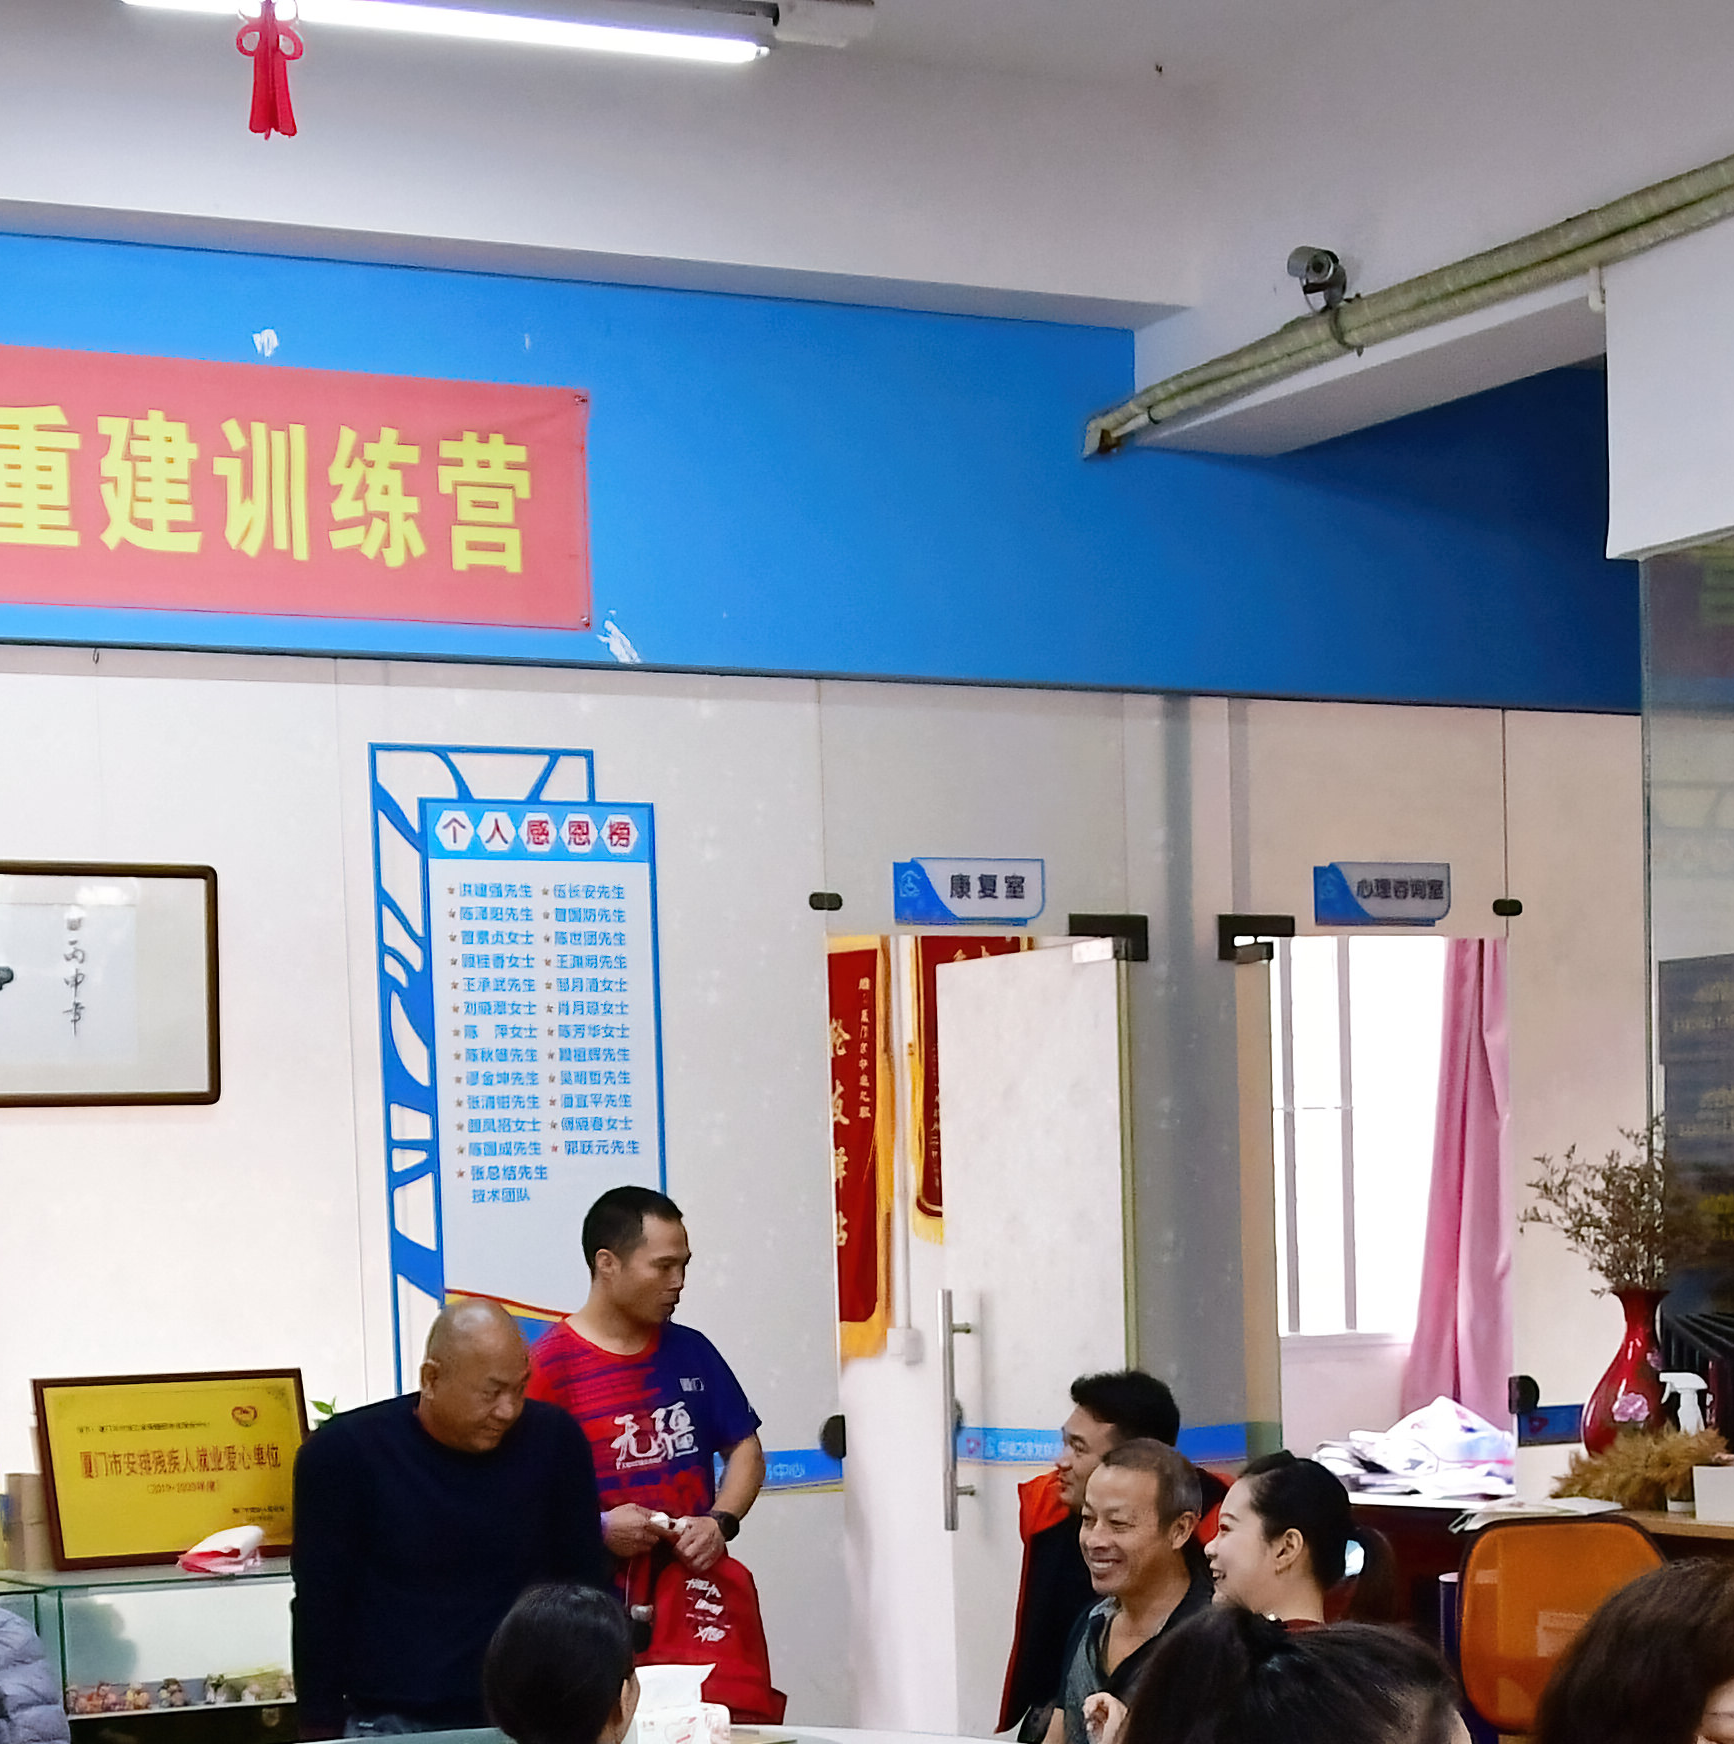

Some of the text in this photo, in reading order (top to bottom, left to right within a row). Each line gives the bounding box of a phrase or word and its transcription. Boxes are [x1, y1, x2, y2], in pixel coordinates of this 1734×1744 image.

[442, 815, 632, 849] 个人感恩榜
[949, 874, 1026, 900] 康复室
[1356, 878, 1445, 899] 心理咨询室
